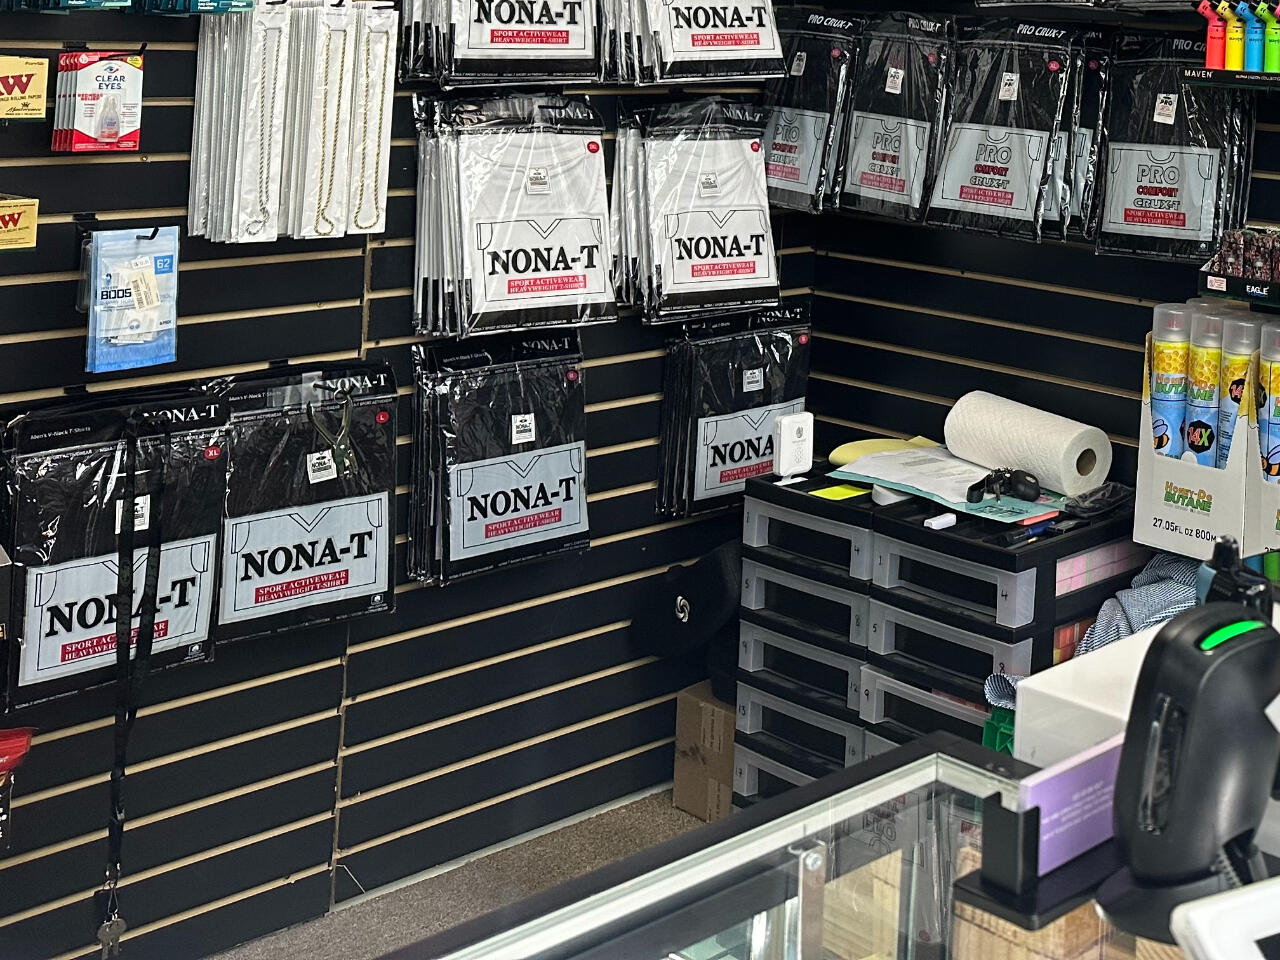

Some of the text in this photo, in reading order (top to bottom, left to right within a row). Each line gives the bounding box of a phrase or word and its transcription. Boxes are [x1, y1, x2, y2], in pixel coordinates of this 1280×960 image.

[672, 6, 767, 31] NONA-T
[1017, 23, 1067, 39] PRO CRUX-T
[95, 75, 125, 83] CLEAR
[1185, 69, 1213, 79] MAVEN
[98, 82, 122, 90] EYES
[548, 107, 595, 121] NONA-T
[723, 106, 764, 122] NONA-T
[1136, 164, 1179, 185] PRO
[1136, 185, 1178, 197] COMFORT
[1133, 198, 1180, 209] CRUX-T
[676, 234, 765, 260] NONA-T
[156, 258, 170, 270] 62
[488, 244, 599, 276] NONA-T
[510, 276, 584, 287] SPORT ACTIVEWEAR
[1246, 285, 1268, 294] EAGLE
[756, 308, 803, 323] NONA-T
[522, 338, 571, 353] NONA-T
[324, 373, 388, 391] NONA-T
[467, 477, 576, 522] NONA-T
[1164, 495, 1212, 512] BUTANE
[487, 509, 560, 531] SPORT ACTIVEWEAR
[240, 530, 373, 581] NONA-T
[258, 570, 347, 595] SPORT ACTIVEWEAR
[258, 586, 316, 602] HEAVYWEIGHT
[66, 639, 97, 653] SPORT
